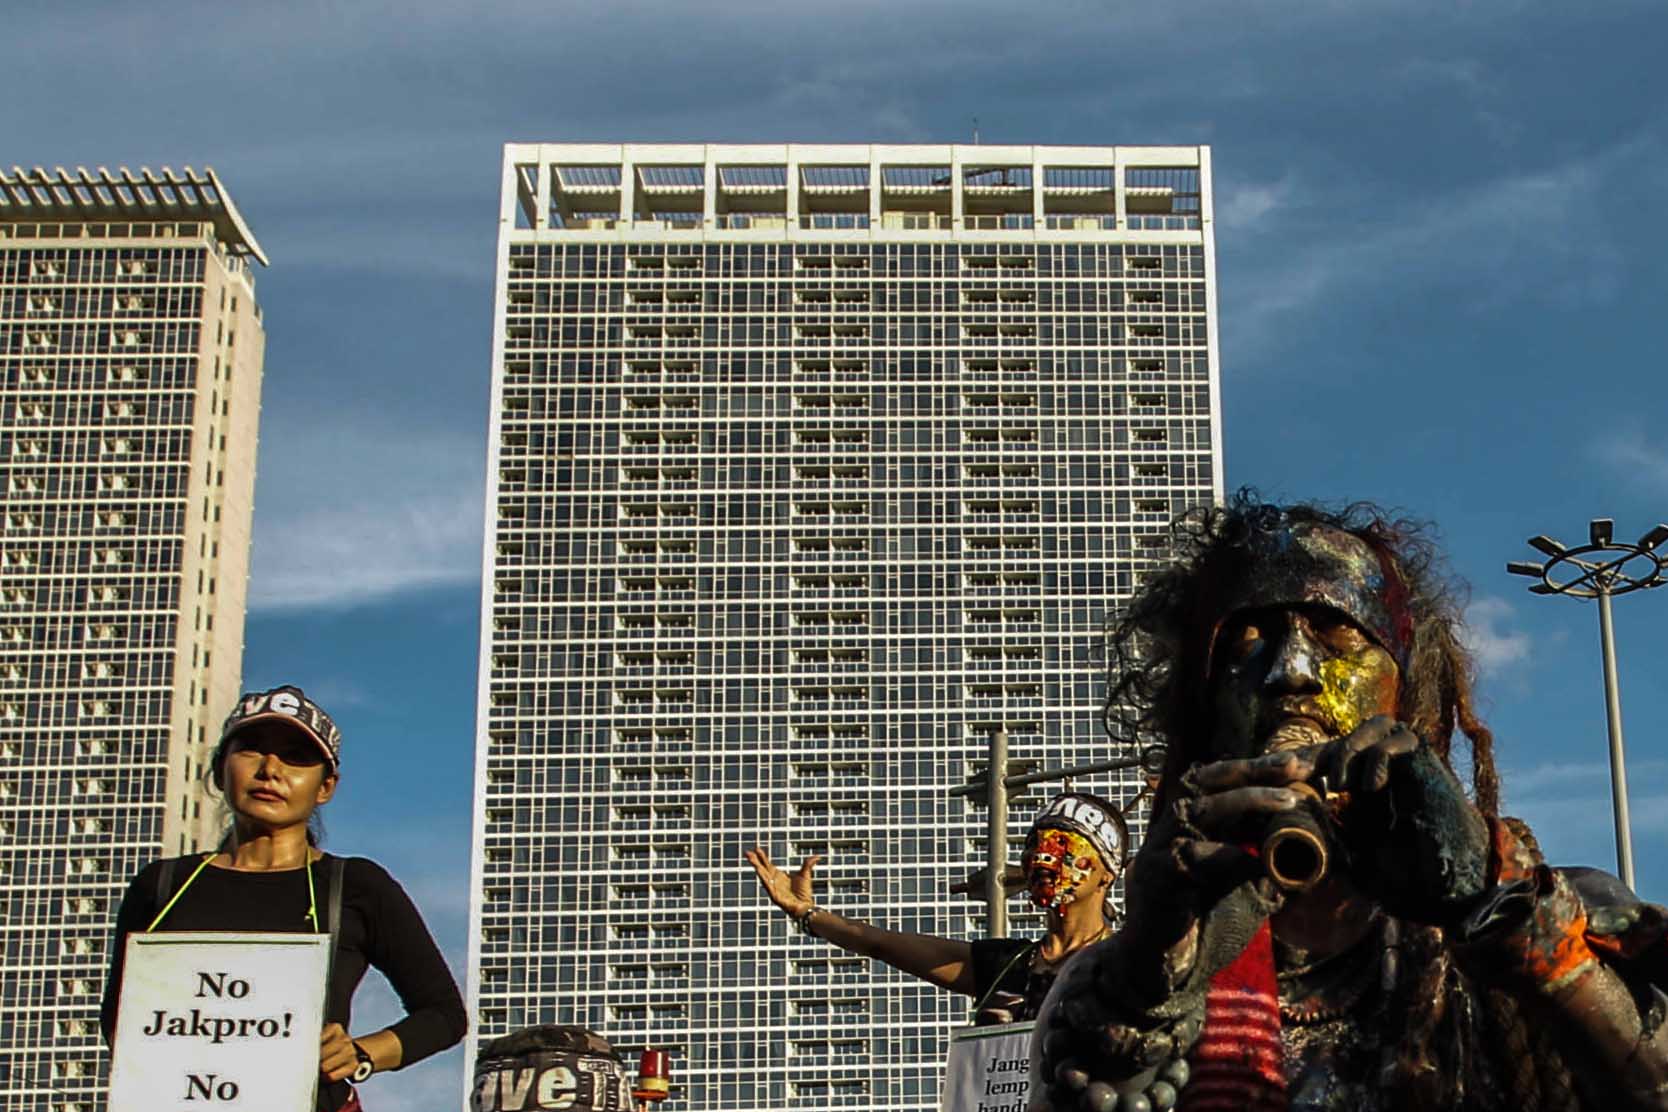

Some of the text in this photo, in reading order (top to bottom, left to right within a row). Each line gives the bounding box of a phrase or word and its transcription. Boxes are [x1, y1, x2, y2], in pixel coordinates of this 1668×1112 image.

[196, 972, 250, 999] No
[144, 1009, 292, 1044] Jakpro!
[987, 1058, 1029, 1074] Jang
[185, 1075, 239, 1101] No
[985, 1079, 1028, 1096] lemp
